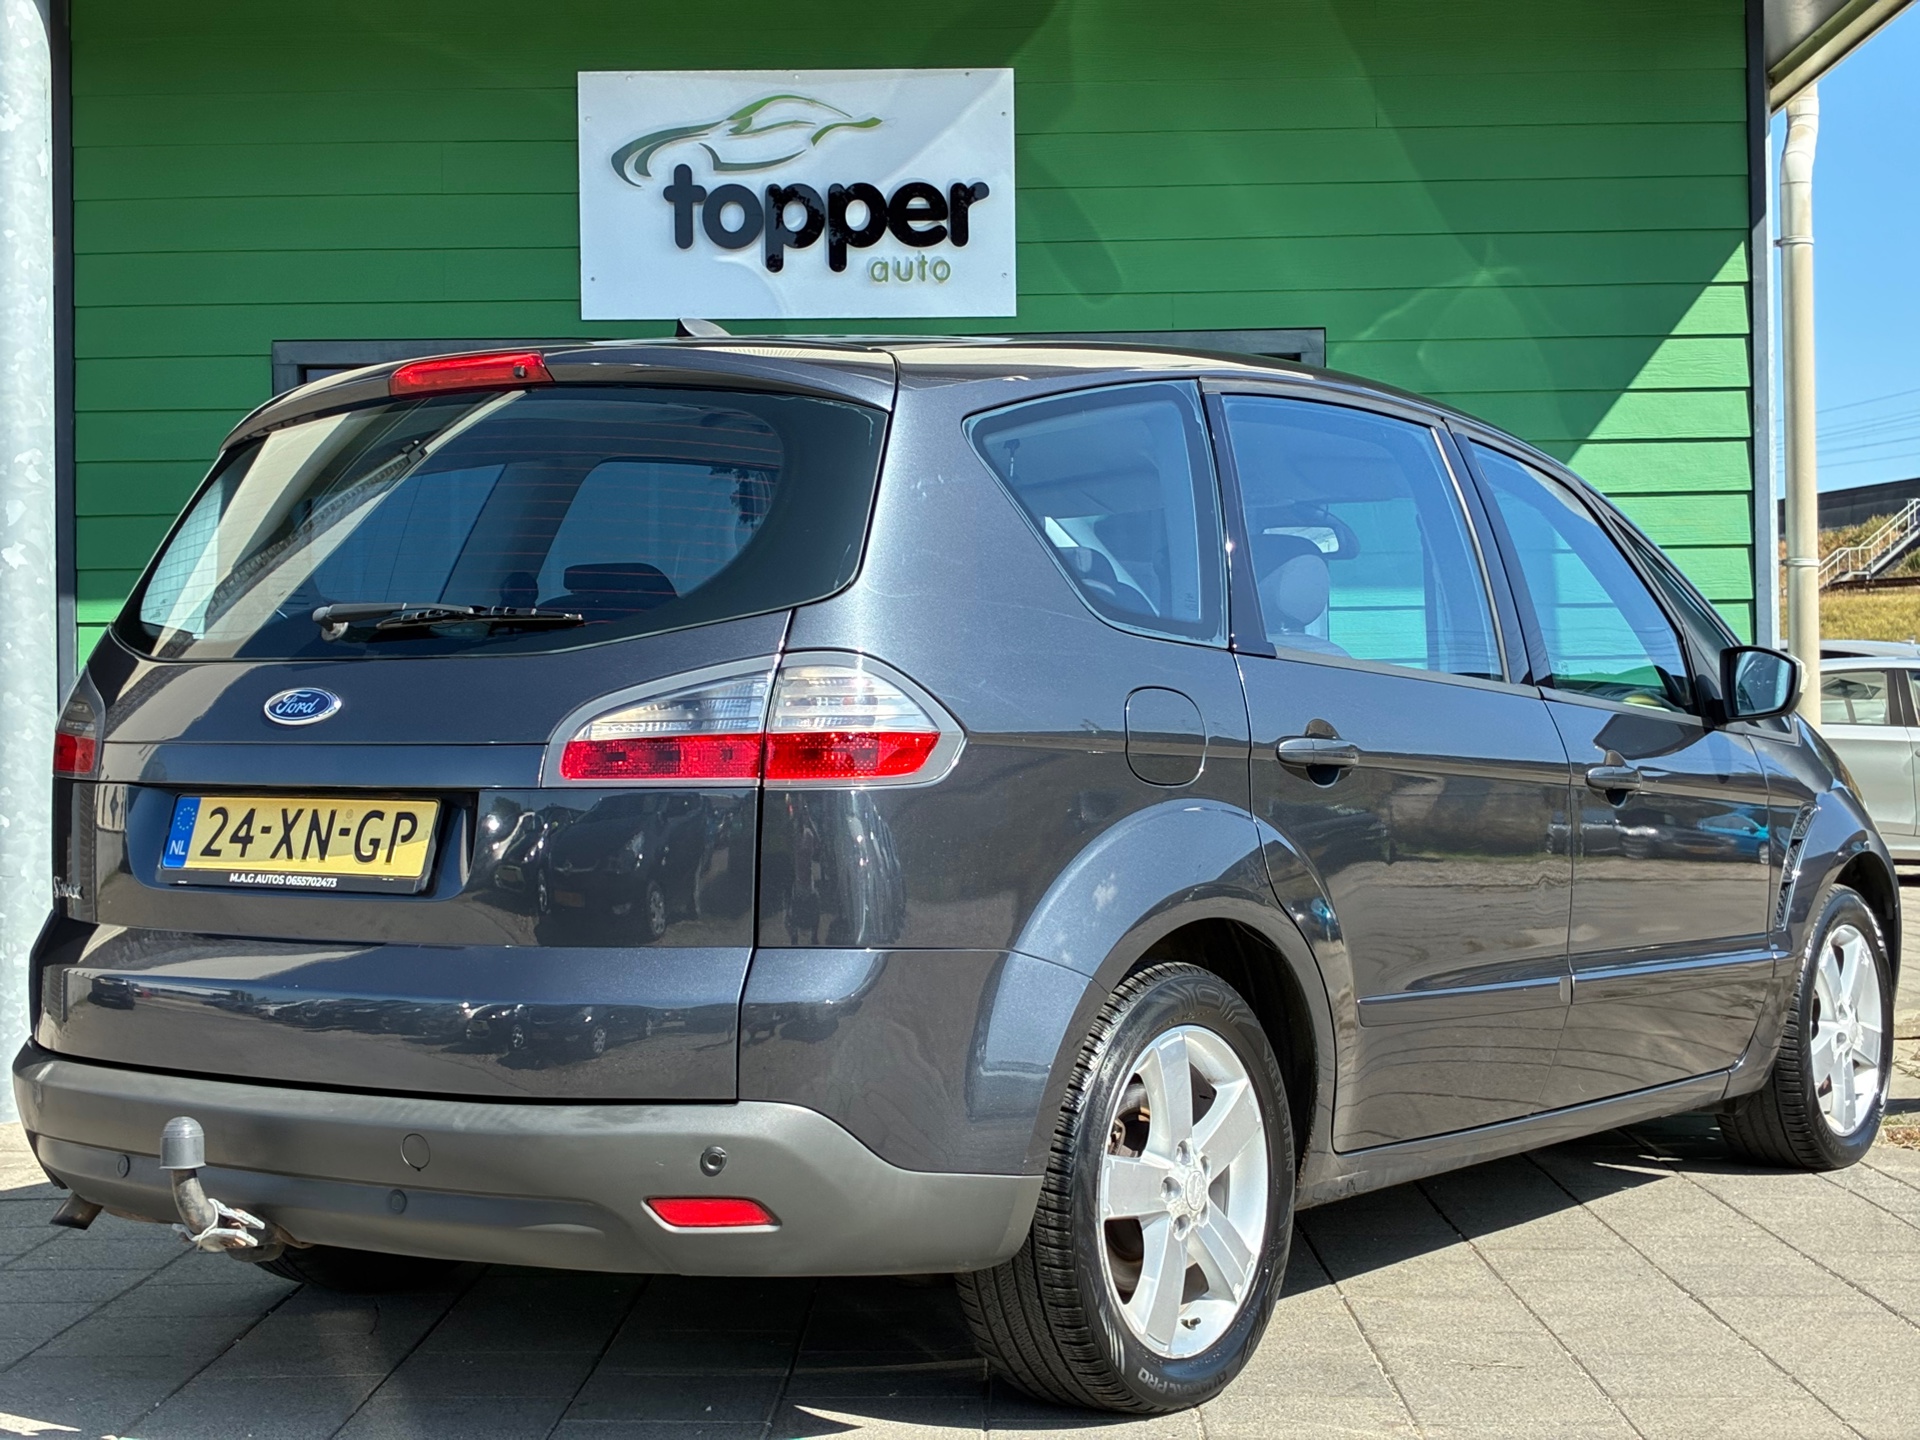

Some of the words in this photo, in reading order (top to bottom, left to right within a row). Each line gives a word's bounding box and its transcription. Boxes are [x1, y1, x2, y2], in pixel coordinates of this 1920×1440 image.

[662, 163, 990, 274] topper
[870, 255, 952, 283] auto
[275, 692, 320, 714] Ford
[168, 839, 186, 856] NL
[199, 806, 418, 865] 24-XN-GP
[255, 875, 285, 885] AUTOS
[286, 875, 338, 888] 0655702473
